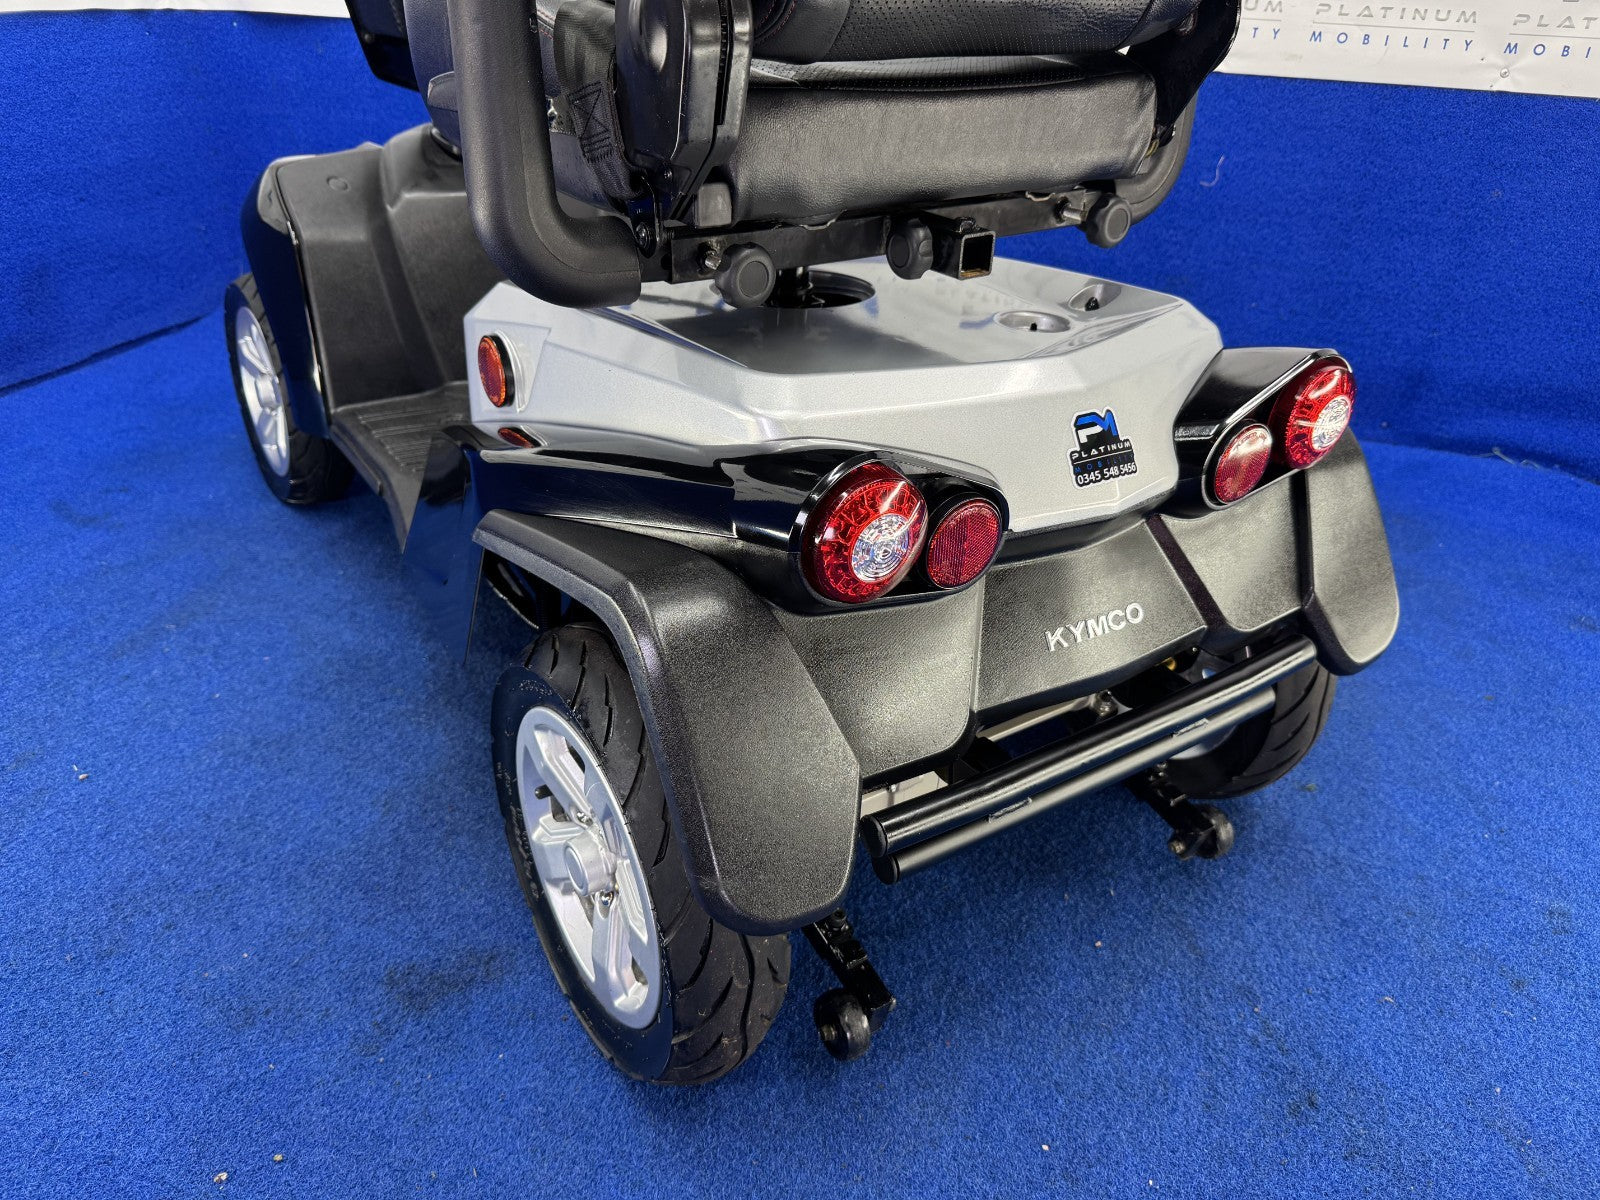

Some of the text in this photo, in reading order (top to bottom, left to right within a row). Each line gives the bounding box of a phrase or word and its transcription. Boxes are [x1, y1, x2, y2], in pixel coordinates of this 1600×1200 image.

[1316, 3, 1477, 23] PLATINUM
[1512, 13, 1599, 30] PLAT
[1309, 31, 1474, 51] MOBILITY
[1503, 42, 1592, 59] MOBI
[1071, 441, 1131, 460] PLATINUM
[1077, 462, 1137, 485] 0345 548 5456
[1044, 602, 1144, 652] KYMCO
